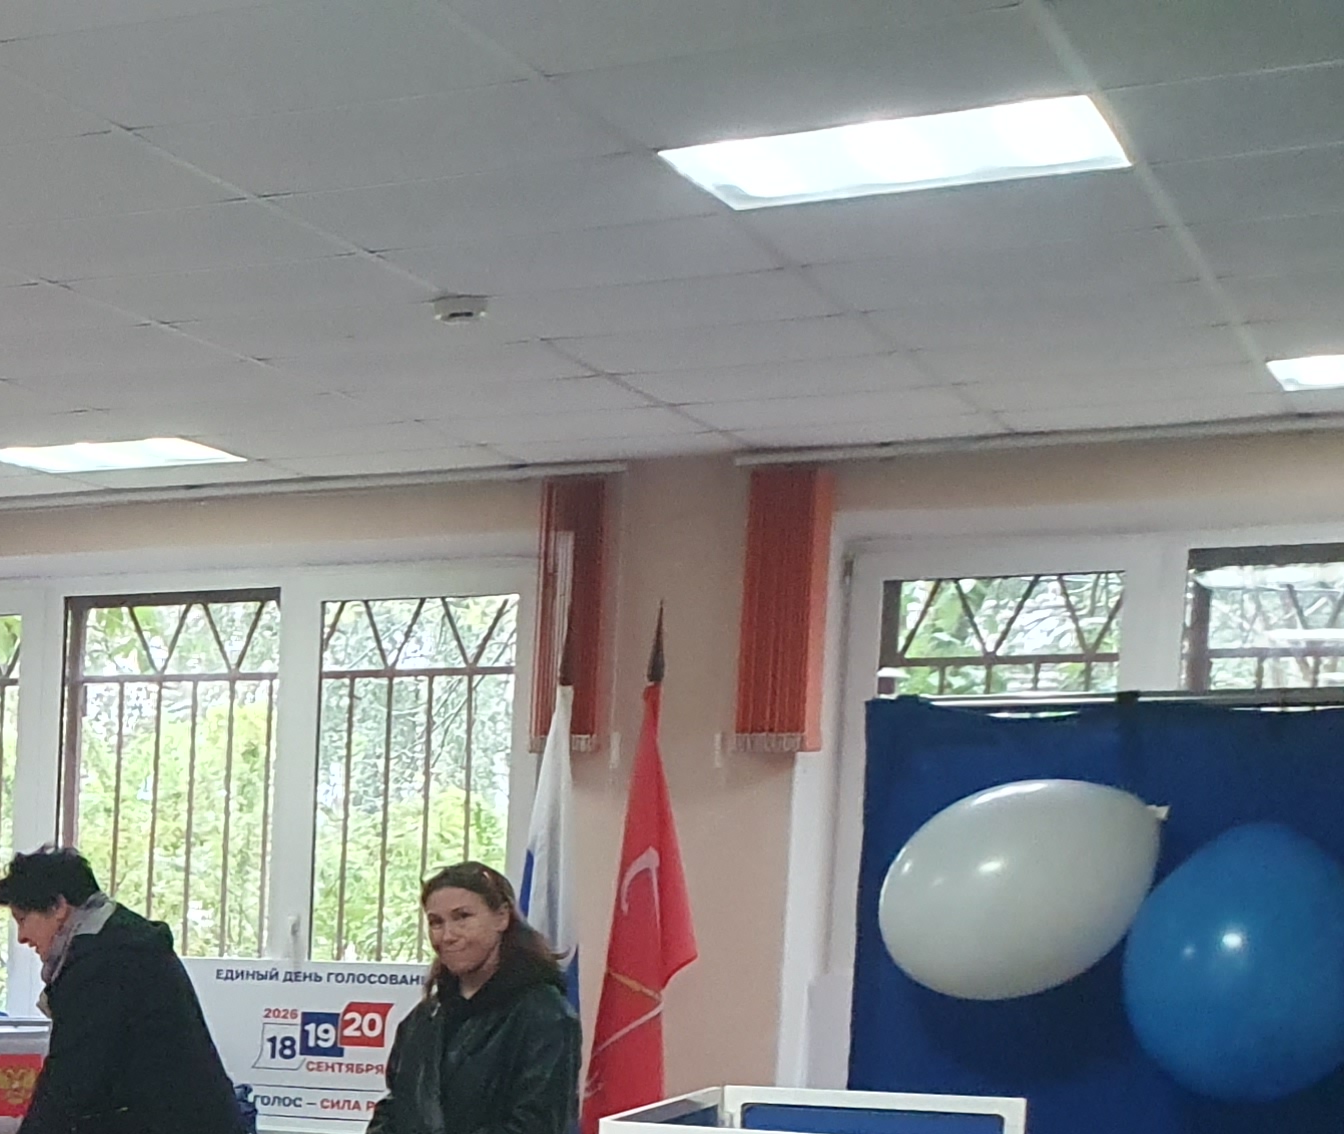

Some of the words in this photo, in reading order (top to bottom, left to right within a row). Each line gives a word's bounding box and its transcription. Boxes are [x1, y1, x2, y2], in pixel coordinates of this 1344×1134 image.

[215, 967, 279, 982] ЕДИНЫЙ
[282, 970, 323, 984] ДЕНЬ
[326, 972, 426, 986] ГОЛОСОВАН
[263, 1007, 299, 1020] 2026
[266, 1035, 297, 1060] 18
[304, 1022, 336, 1048] 19
[342, 1011, 383, 1038] 20
[305, 1060, 385, 1075] СЕНТЯБРЯ
[253, 1094, 303, 1108] ГОЛОС
[320, 1098, 362, 1111] СИЛА
